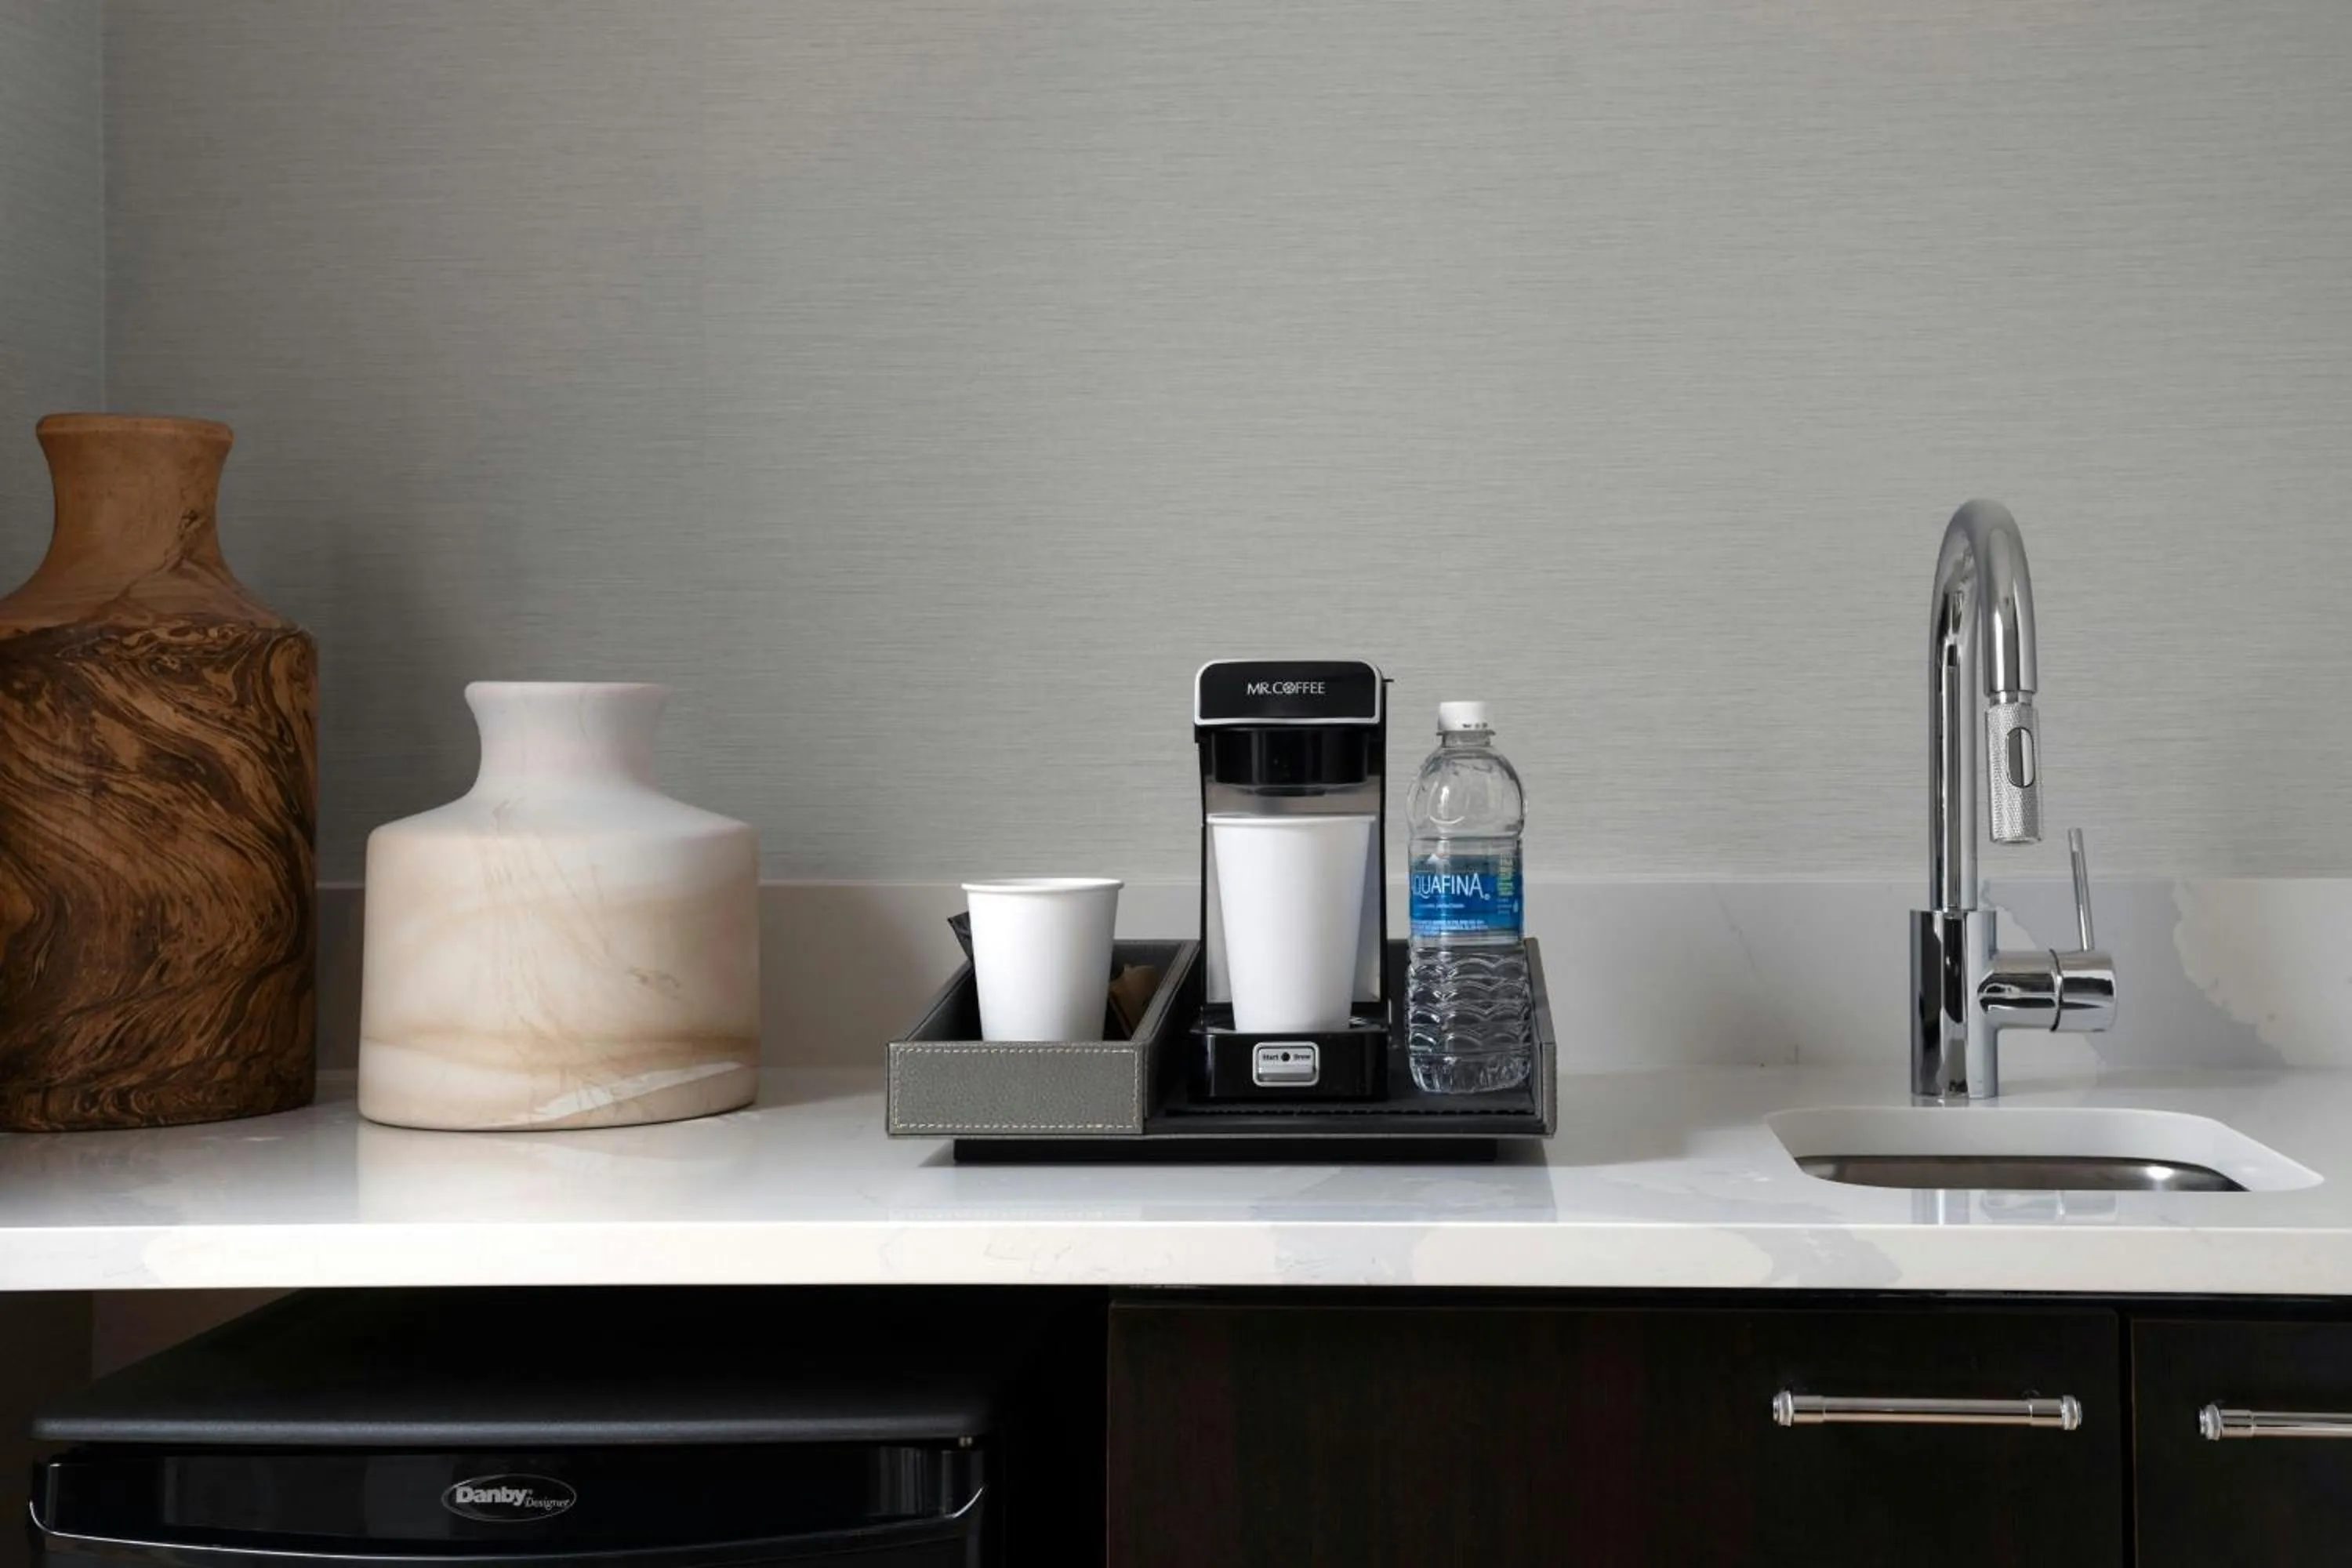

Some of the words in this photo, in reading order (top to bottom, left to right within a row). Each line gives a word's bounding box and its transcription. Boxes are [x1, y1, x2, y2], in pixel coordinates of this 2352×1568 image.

[1411, 872, 1485, 900] QUAFINA
[456, 1486, 528, 1506] Danby
[524, 1497, 570, 1510] Designer
